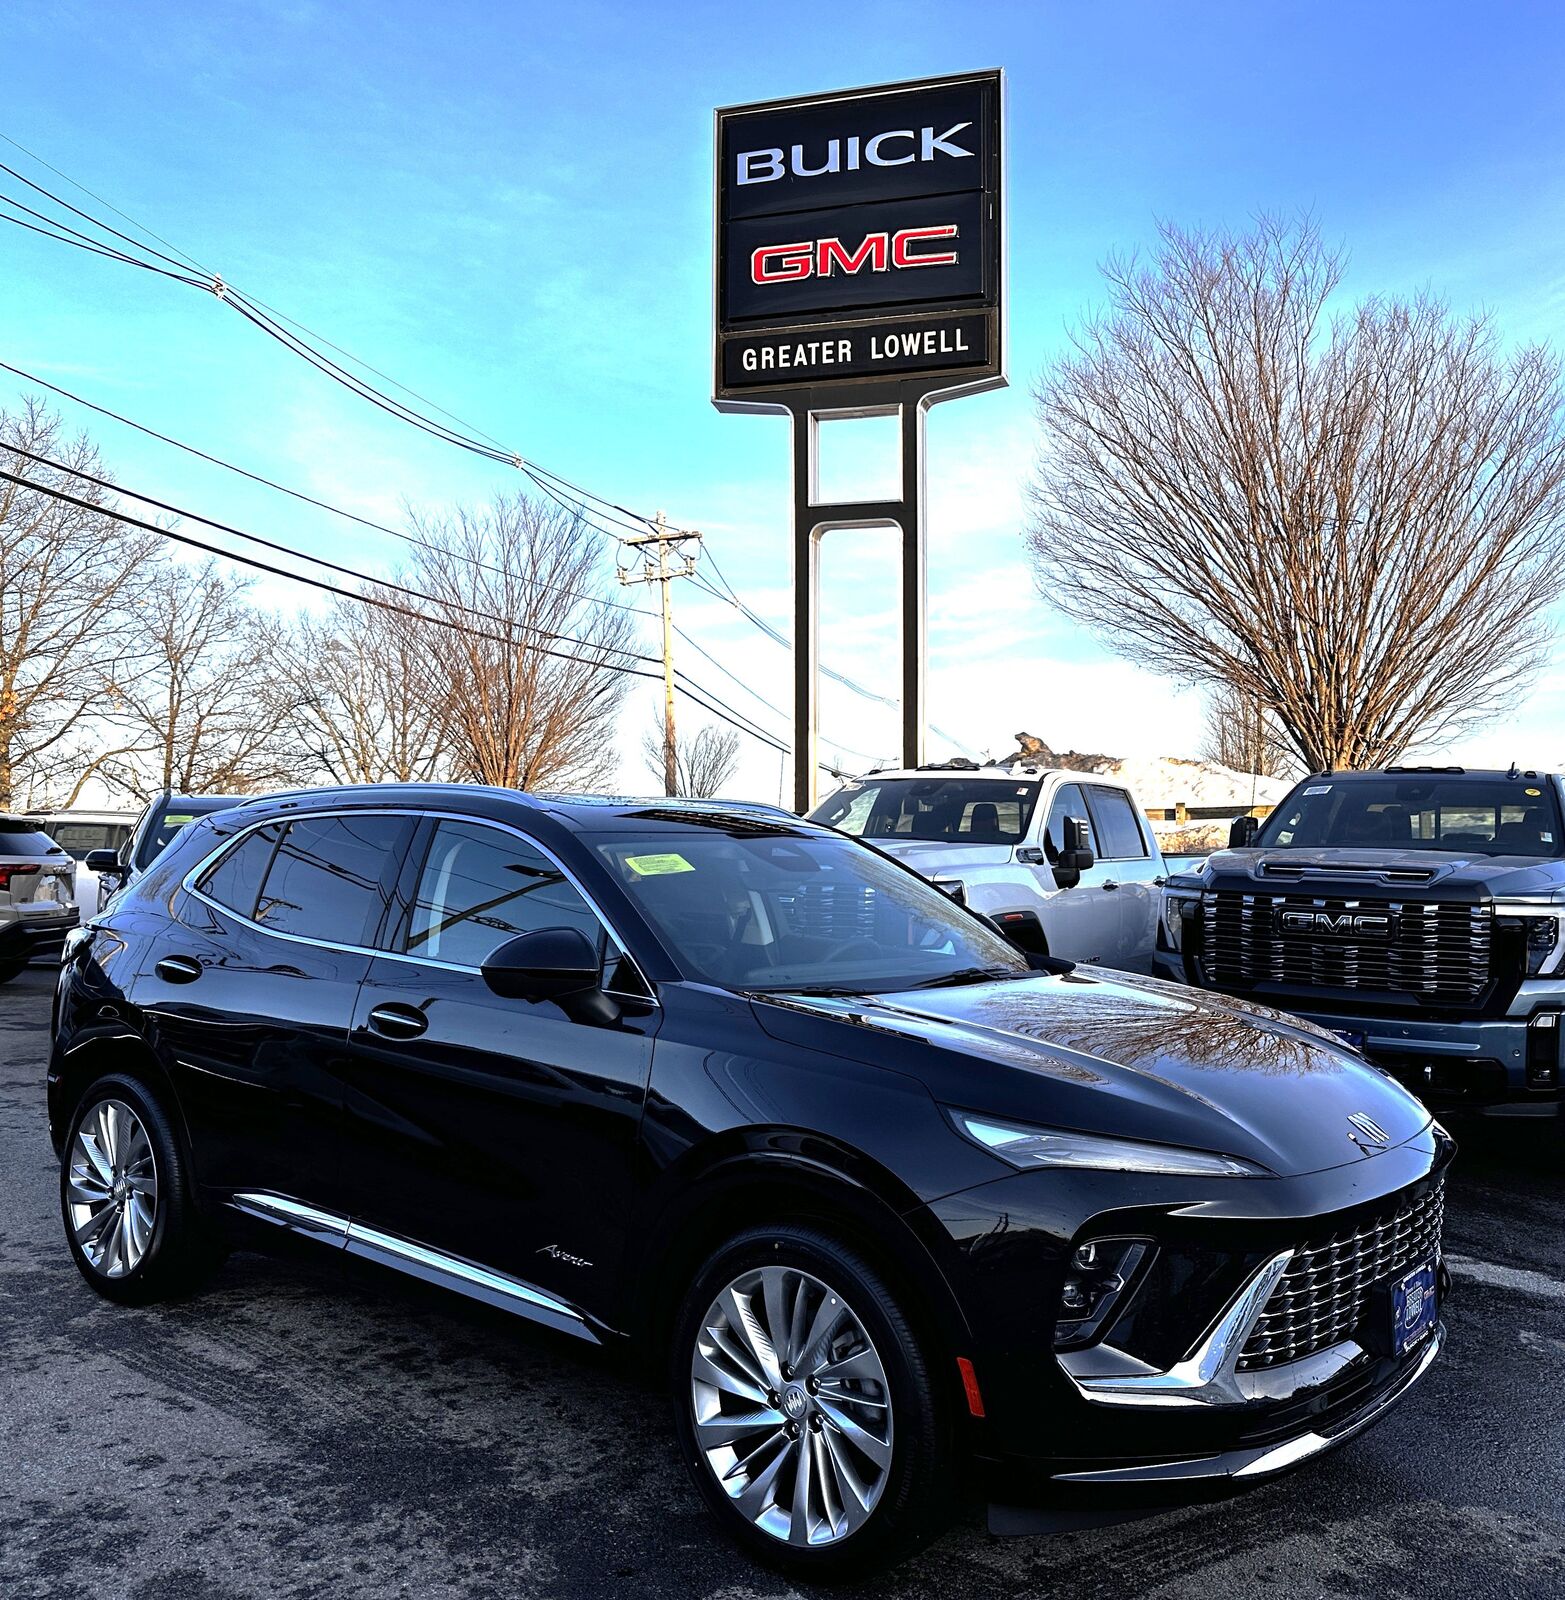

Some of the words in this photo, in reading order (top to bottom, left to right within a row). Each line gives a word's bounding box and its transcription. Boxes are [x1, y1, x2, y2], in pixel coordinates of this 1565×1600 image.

[737, 122, 975, 185] BUICK
[751, 225, 959, 285] GMC
[742, 339, 852, 371] GREATER
[871, 328, 969, 359] LOWELL
[1282, 911, 1389, 936] GMC
